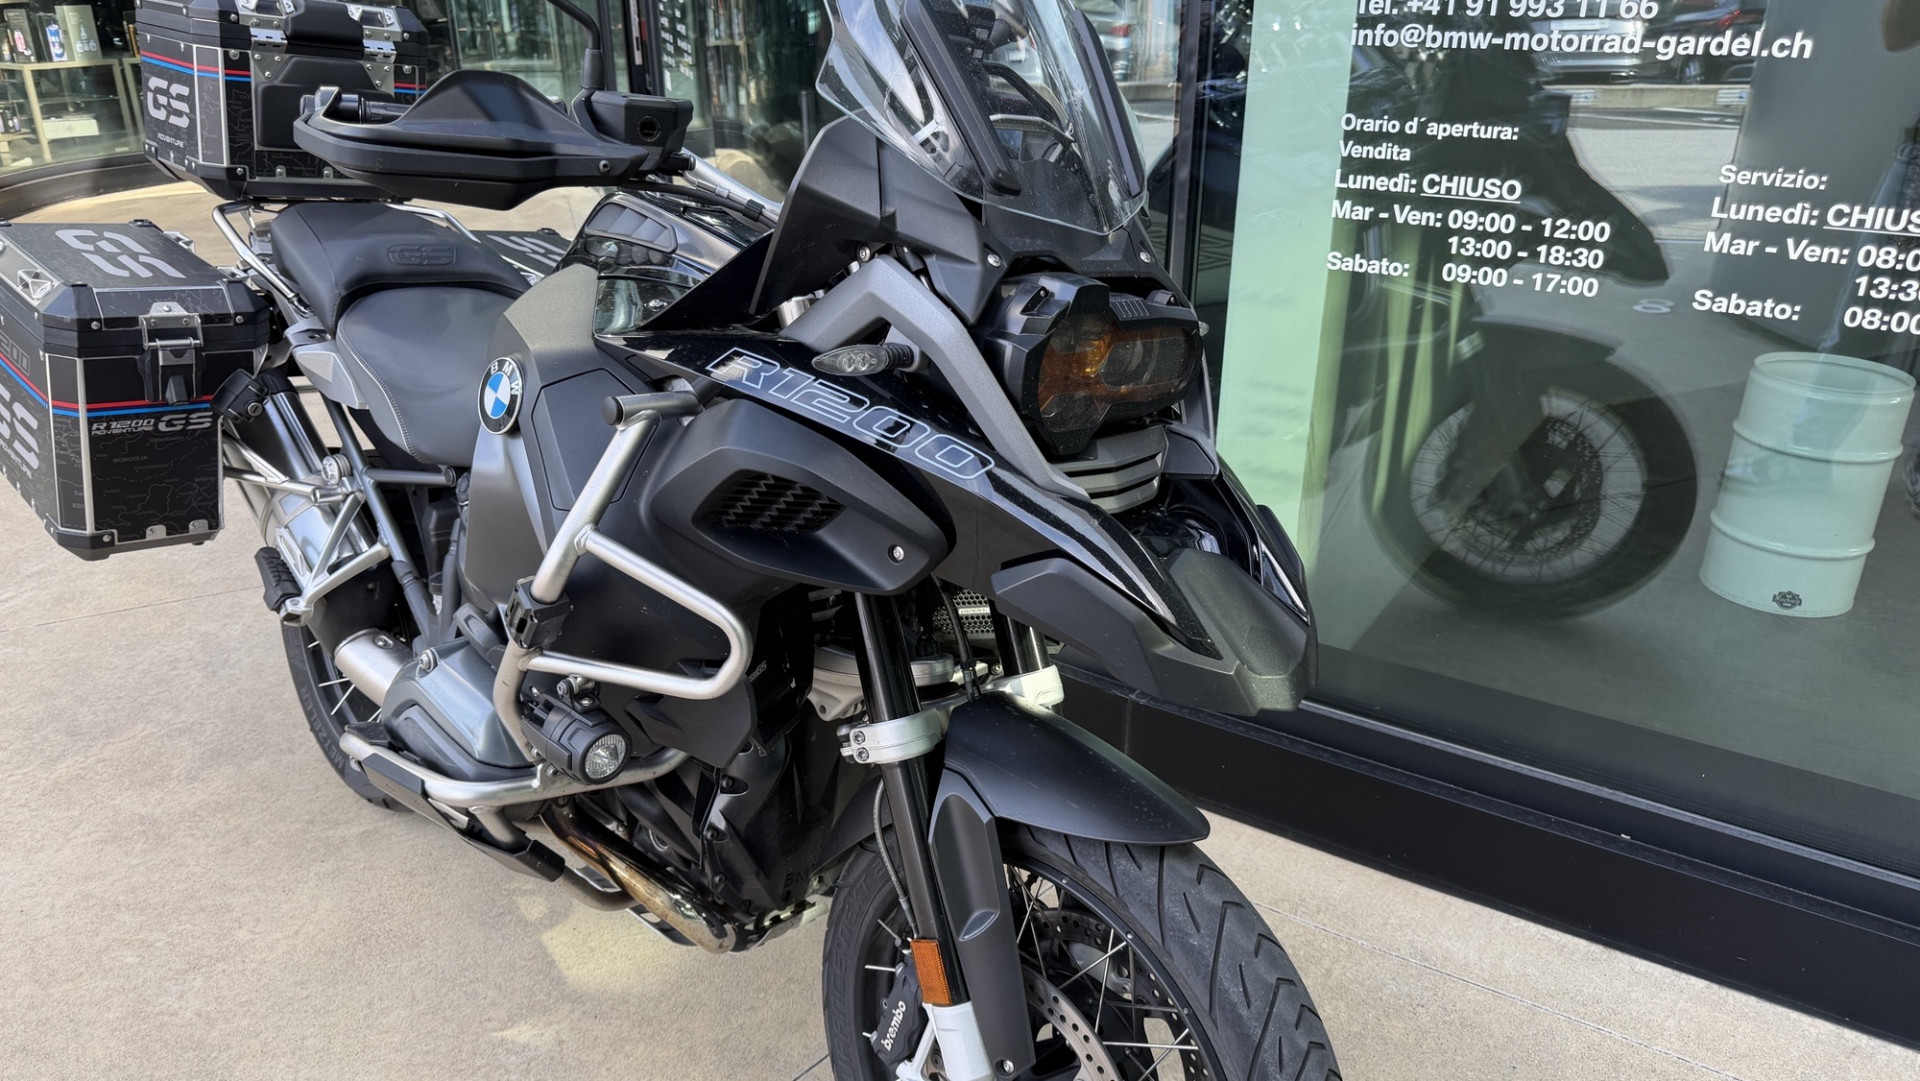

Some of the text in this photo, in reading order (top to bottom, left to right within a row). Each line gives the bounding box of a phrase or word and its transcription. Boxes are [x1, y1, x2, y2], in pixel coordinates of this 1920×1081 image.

[1358, 0, 1660, 19] Tel. +41 91 993 11 66
[146, 76, 190, 129] GS
[1340, 113, 1401, 134] Orario
[1339, 140, 1412, 162] Vendita
[1334, 169, 1522, 203] Lunedì: CHIUSO
[1718, 163, 1829, 191] Servizio:
[1331, 199, 1375, 222] Mar
[1393, 204, 1443, 228] Ven:
[1448, 208, 1517, 235] 09:00
[1541, 217, 1612, 243] 12:00
[1710, 196, 1820, 227] Lunedì:
[1448, 235, 1513, 260] 13:00
[1536, 244, 1604, 270] 18:30
[1703, 230, 1761, 257] Mar
[1786, 238, 1851, 266] Ven:
[1326, 250, 1411, 278] Sabato:
[1441, 262, 1508, 288] 09:00
[1531, 272, 1600, 298] 17:00
[1854, 275, 1920, 302] 13:3
[1691, 288, 1802, 322] Sabato:
[490, 361, 521, 395] BMW
[158, 411, 214, 432] GS
[705, 346, 996, 480] R1200
[880, 1000, 907, 1052] brembo
